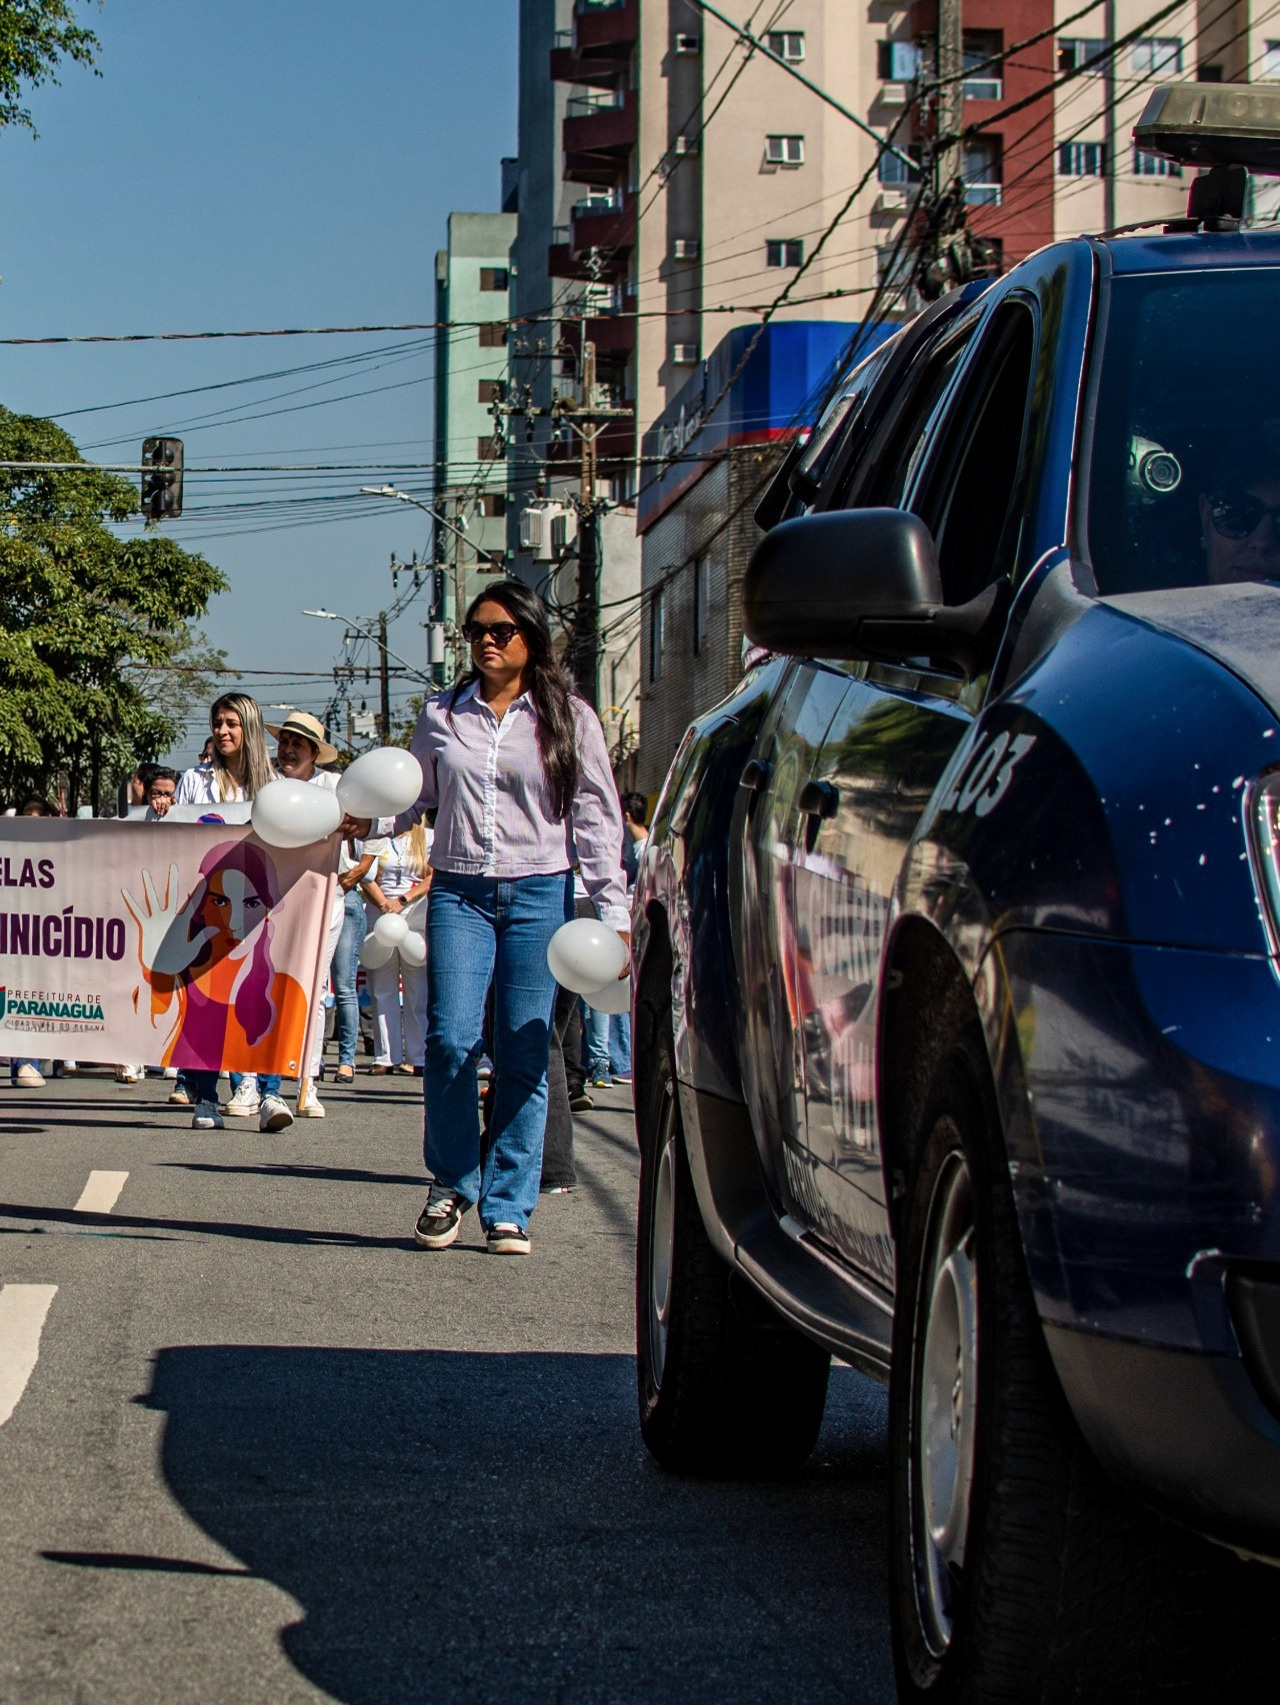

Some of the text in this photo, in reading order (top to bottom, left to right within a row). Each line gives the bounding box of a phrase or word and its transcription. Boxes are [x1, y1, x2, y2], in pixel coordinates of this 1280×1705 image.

[809, 872, 884, 982] GUARD
[7, 990, 102, 1004] PREFEITURA DE
